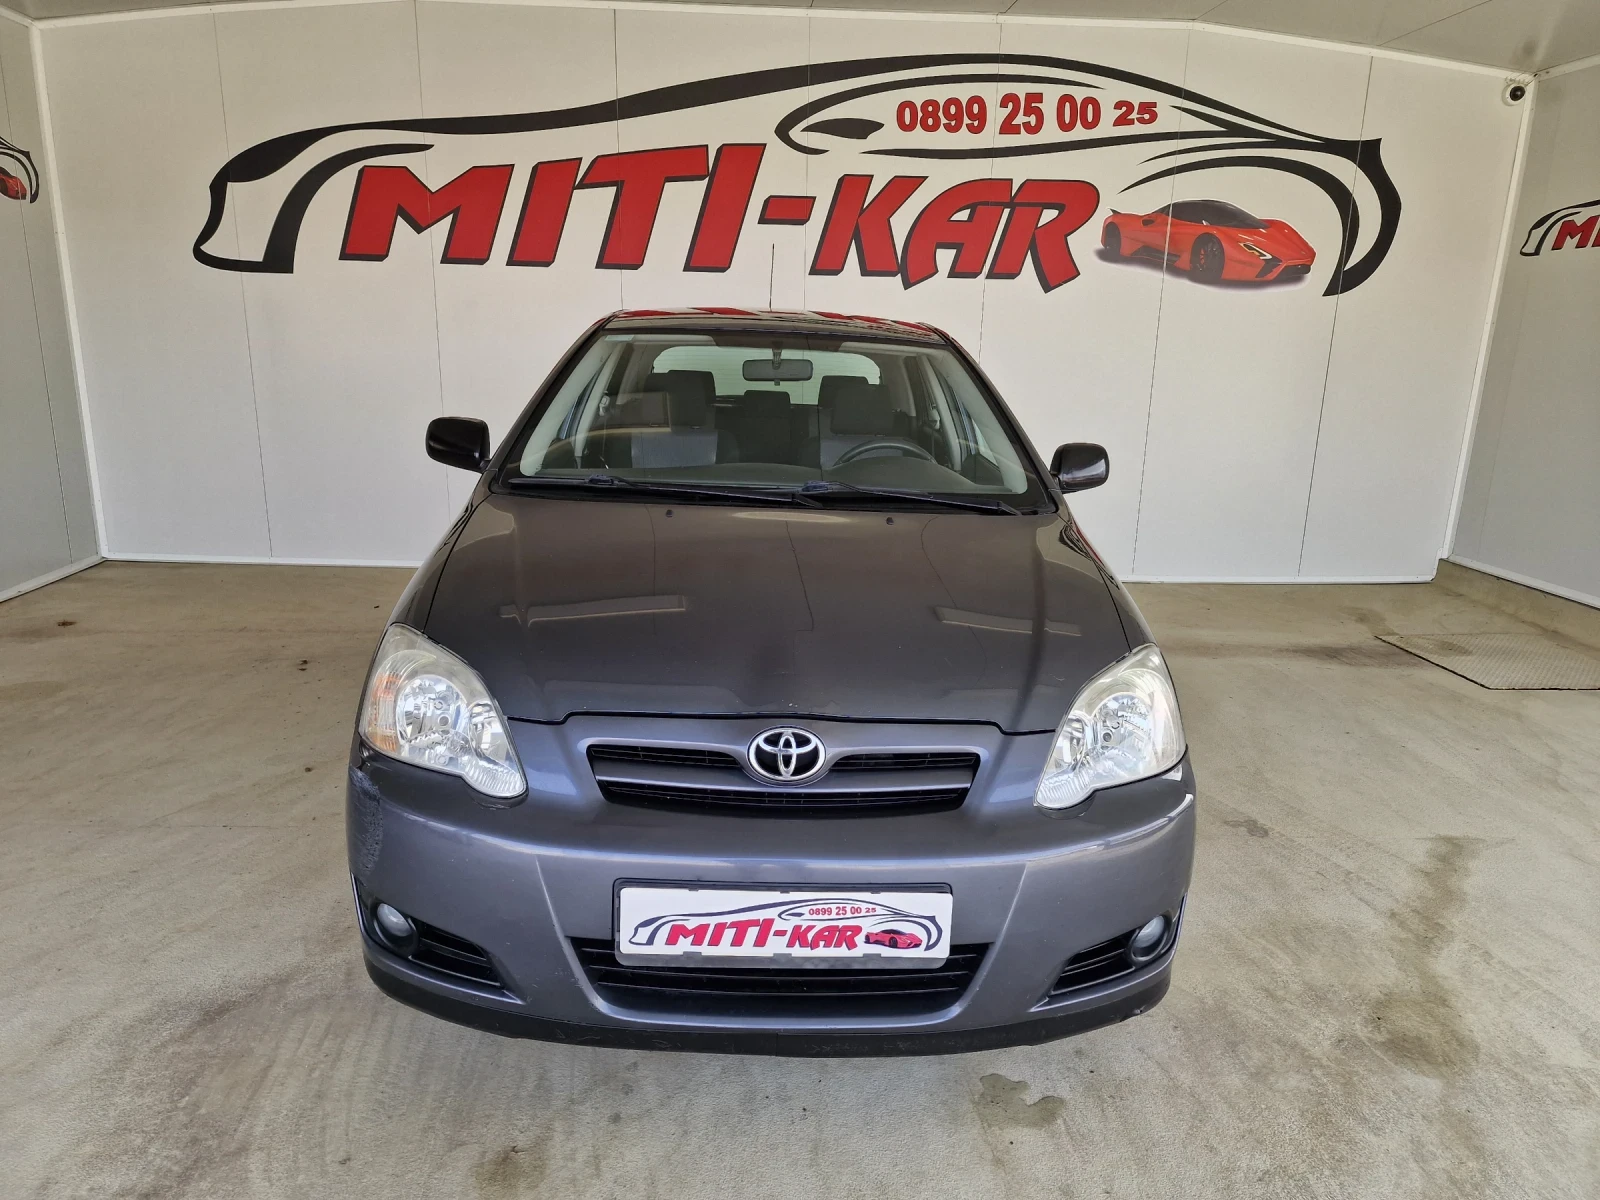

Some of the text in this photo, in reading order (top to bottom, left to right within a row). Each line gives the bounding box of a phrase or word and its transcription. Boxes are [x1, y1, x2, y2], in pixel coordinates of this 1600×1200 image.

[896, 92, 1159, 135] 0899 25 00 25
[339, 143, 1101, 293] MITI-KAR
[1551, 215, 1600, 251] M
[808, 906, 833, 917] 0899
[834, 905, 848, 917] 25
[849, 906, 862, 916] 00
[665, 918, 863, 951] MITI-KAR
